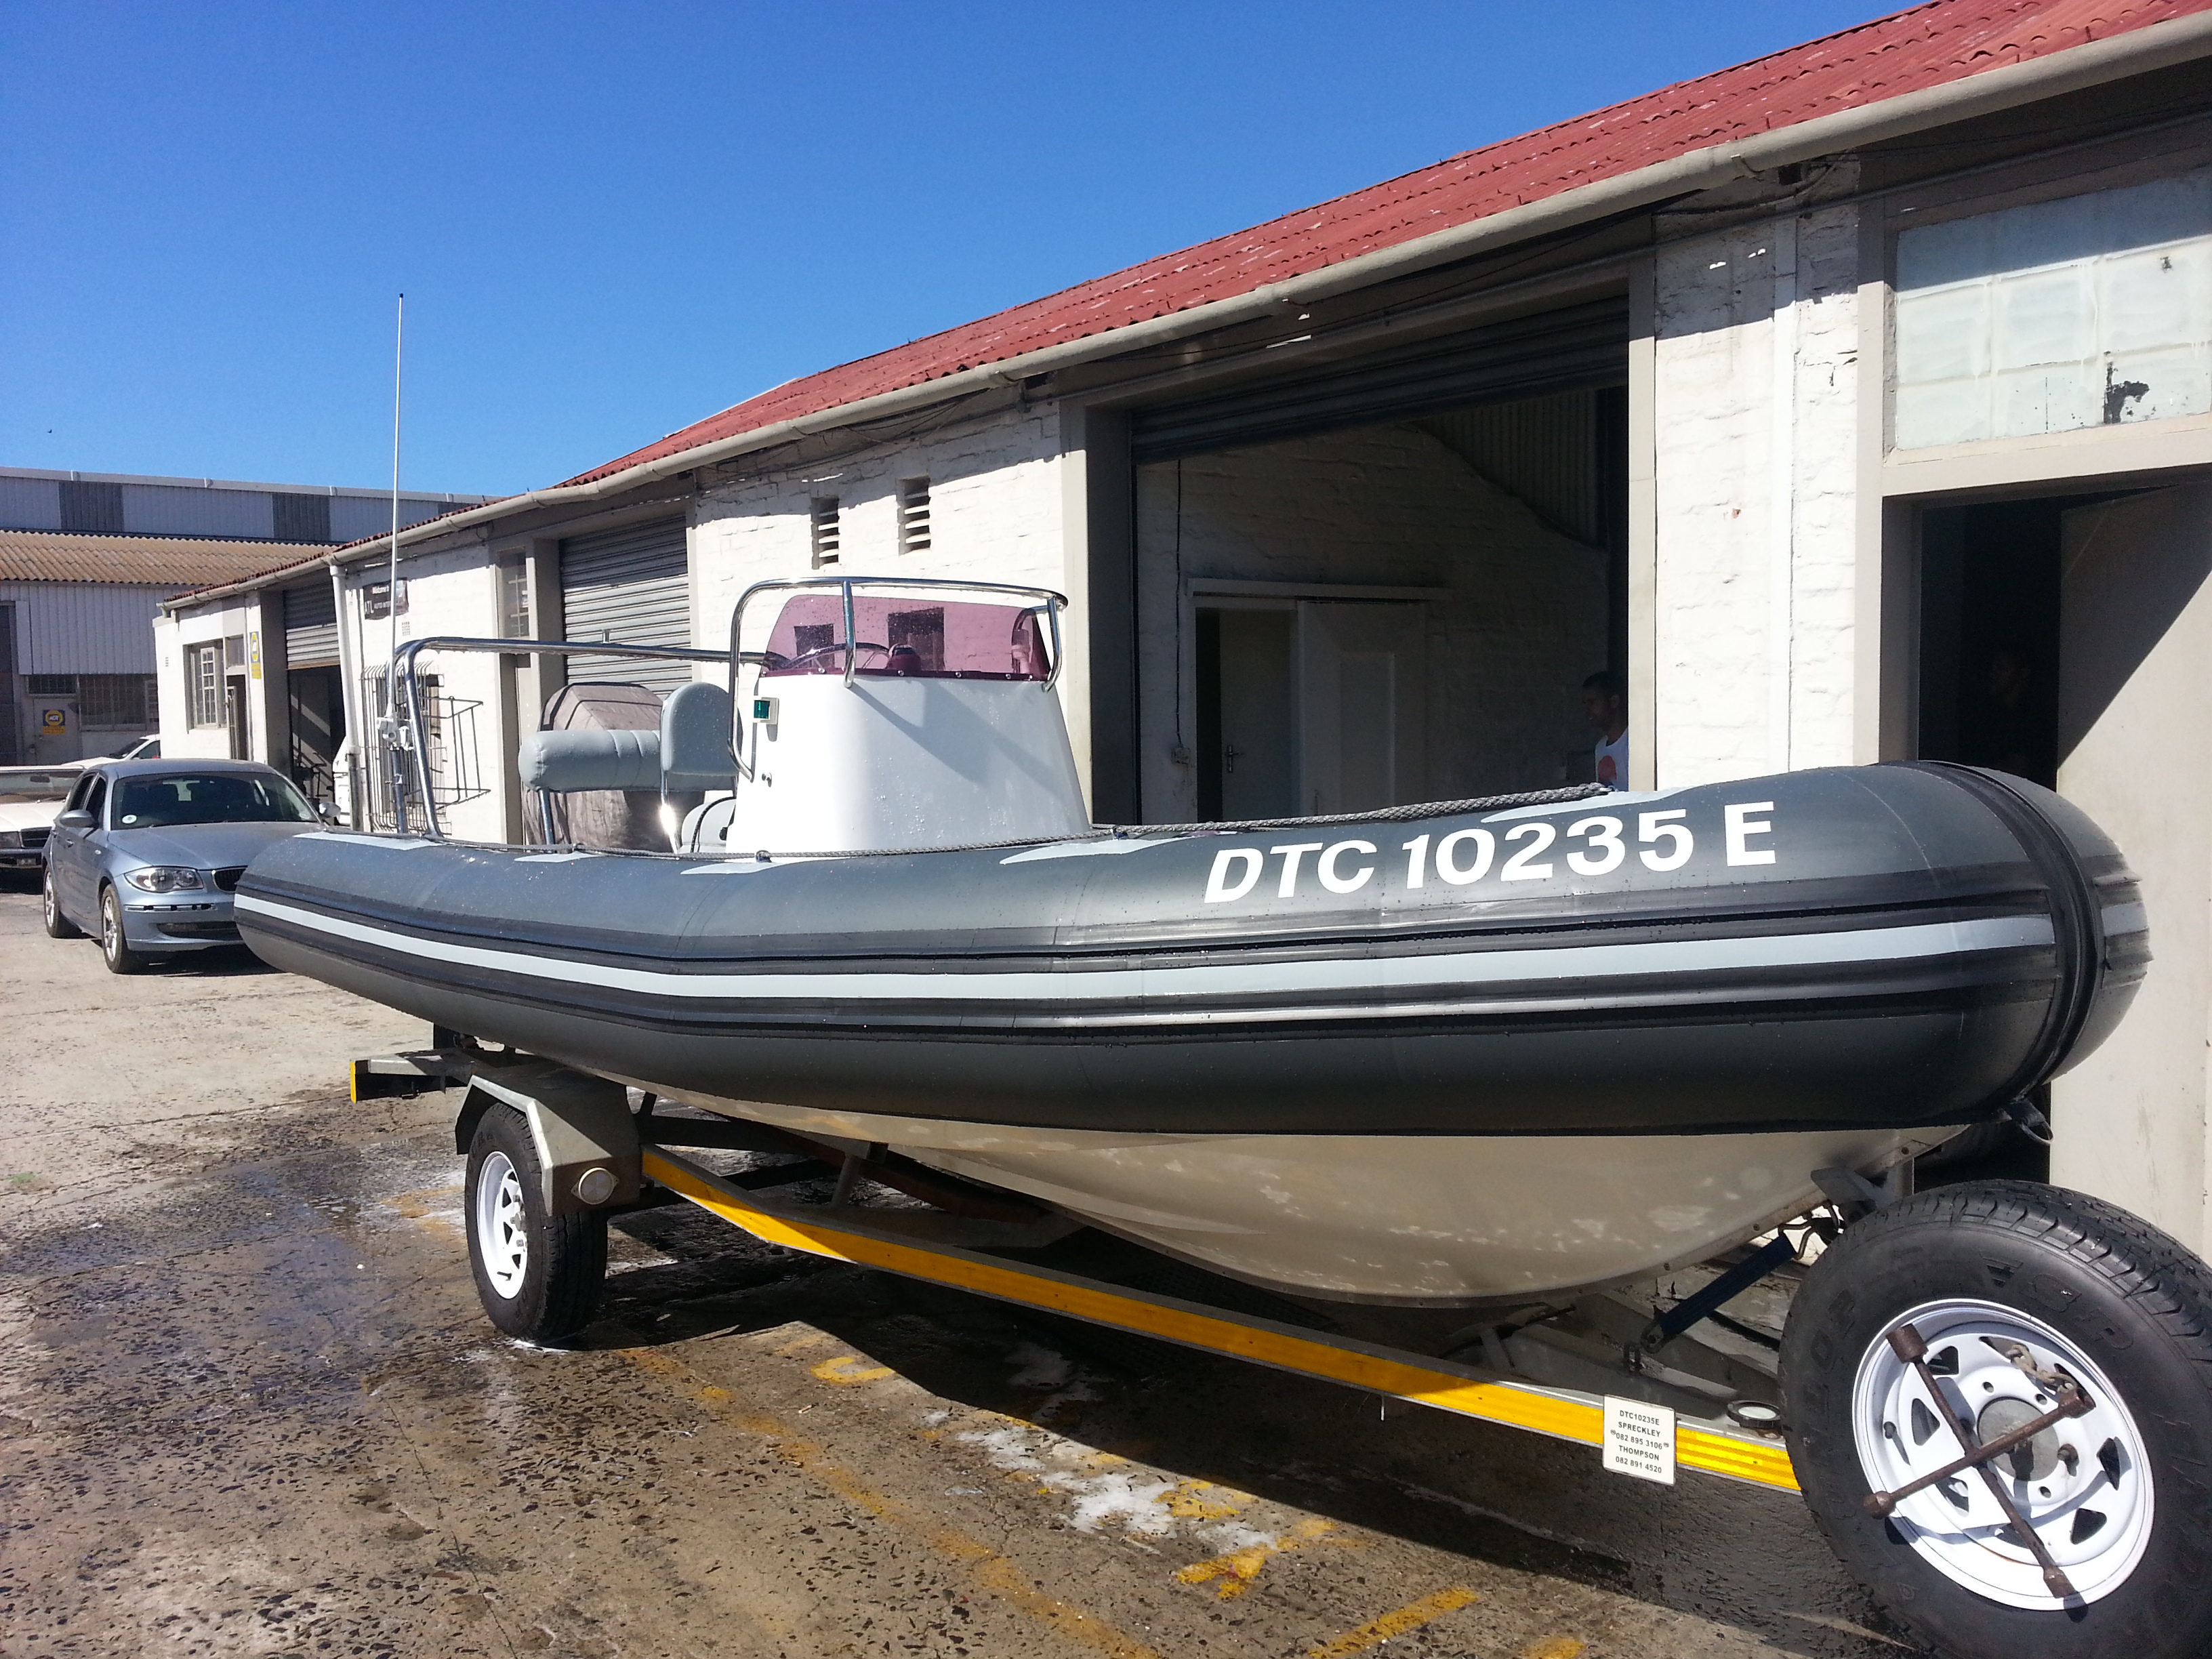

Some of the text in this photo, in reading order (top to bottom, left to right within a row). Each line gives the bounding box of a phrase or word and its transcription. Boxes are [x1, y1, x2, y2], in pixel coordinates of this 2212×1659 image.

[1204, 801, 1776, 903] DTC 10235 E
[1619, 1410, 1660, 1425] DTC10235E
[1618, 1421, 1661, 1437] SPRECKLEY
[1616, 1432, 1629, 1441] 082
[1645, 1439, 1662, 1450] 3106
[1618, 1445, 1660, 1461] THOMPSON
[1615, 1456, 1662, 1473] 082 891 4520
